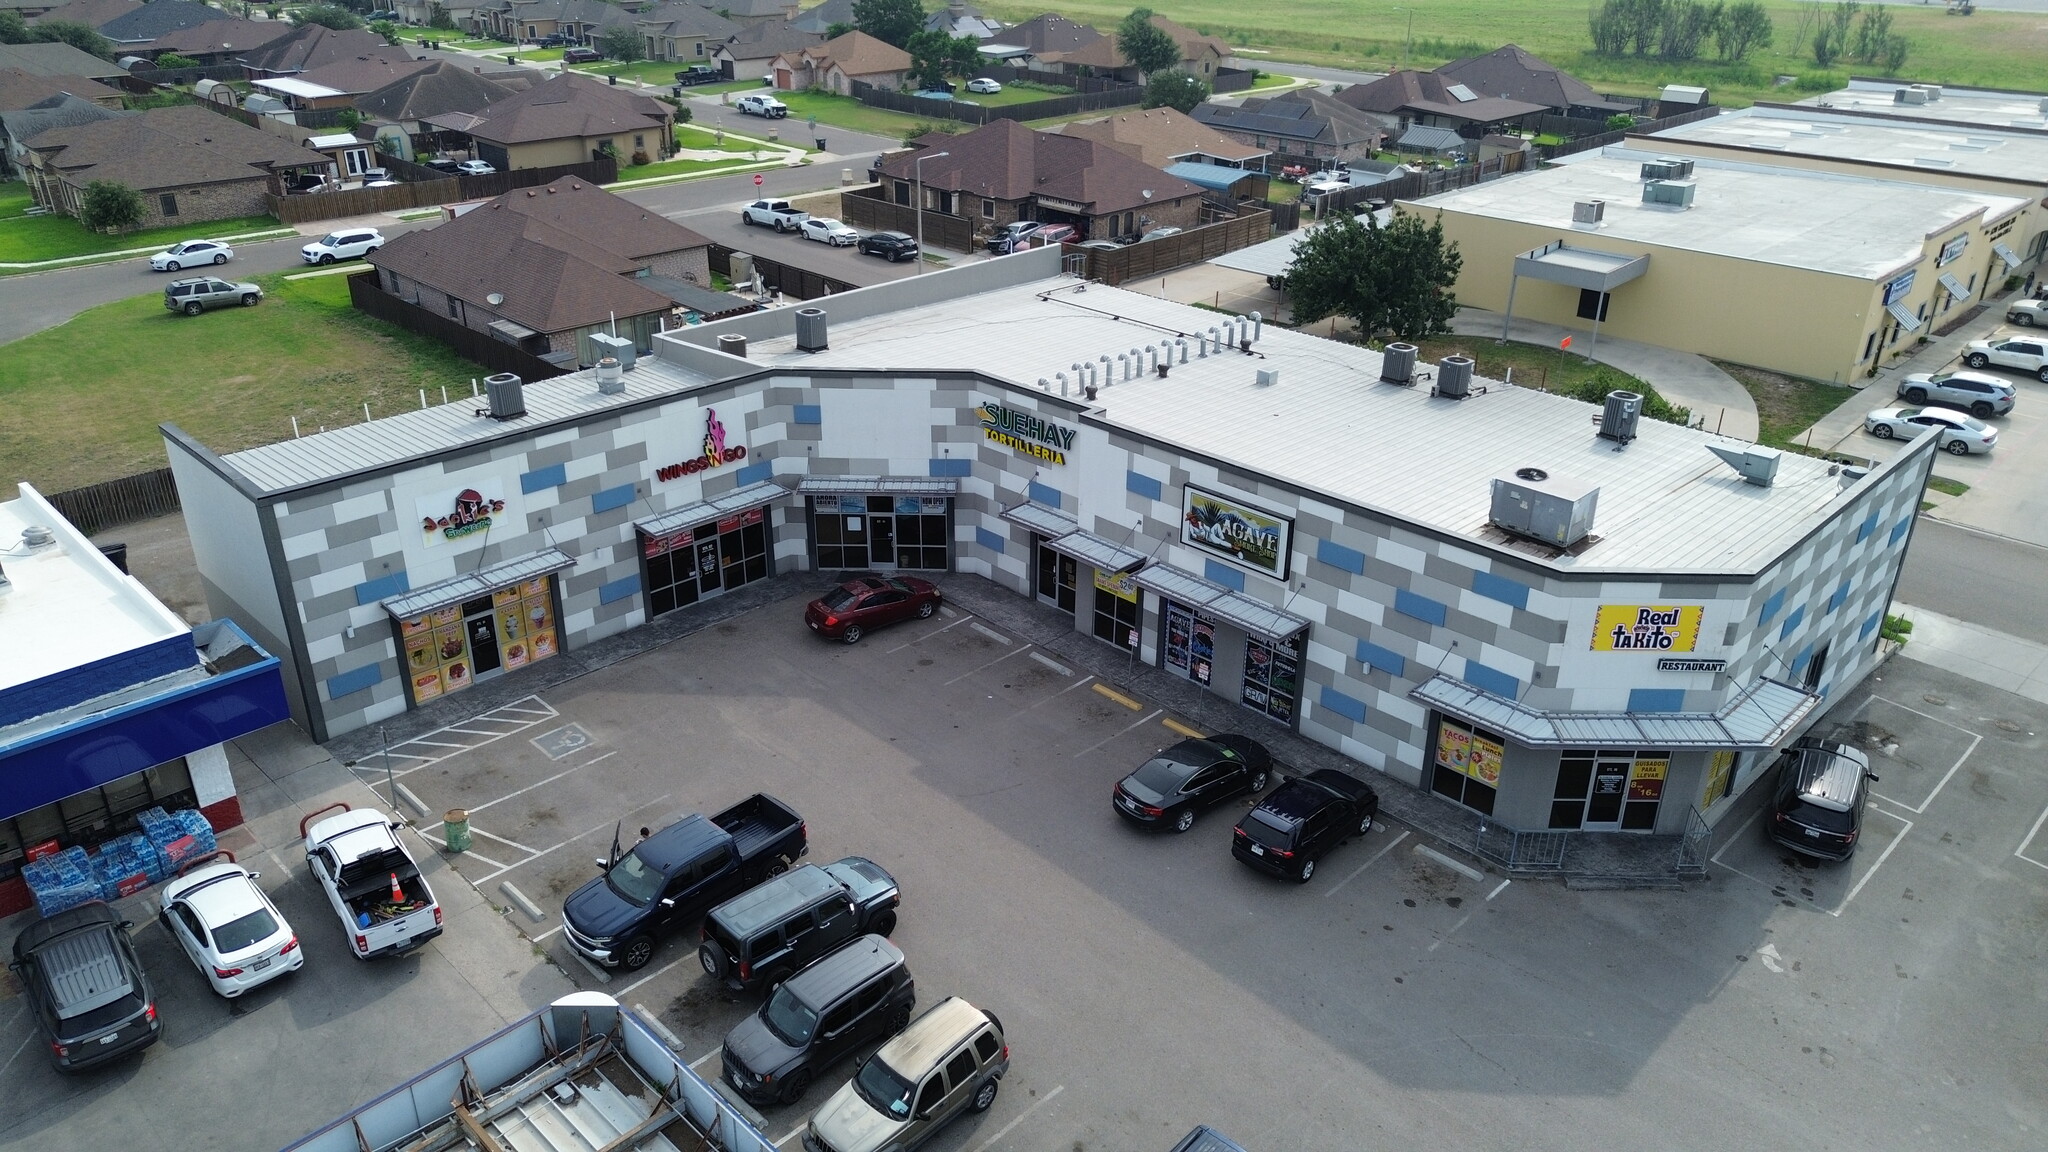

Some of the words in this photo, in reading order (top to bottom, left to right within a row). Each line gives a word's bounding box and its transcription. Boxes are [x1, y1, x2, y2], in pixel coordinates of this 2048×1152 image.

[980, 403, 1077, 451] SUEHAY
[984, 427, 1066, 466] TORTILLERIA
[656, 456, 710, 482] WINGS
[1222, 519, 1279, 552] AGAVE
[1637, 608, 1679, 626] Real
[1661, 662, 1725, 672] RESTAURANT
[1443, 728, 1469, 744] TACOS
[1482, 745, 1503, 757] Lunch
